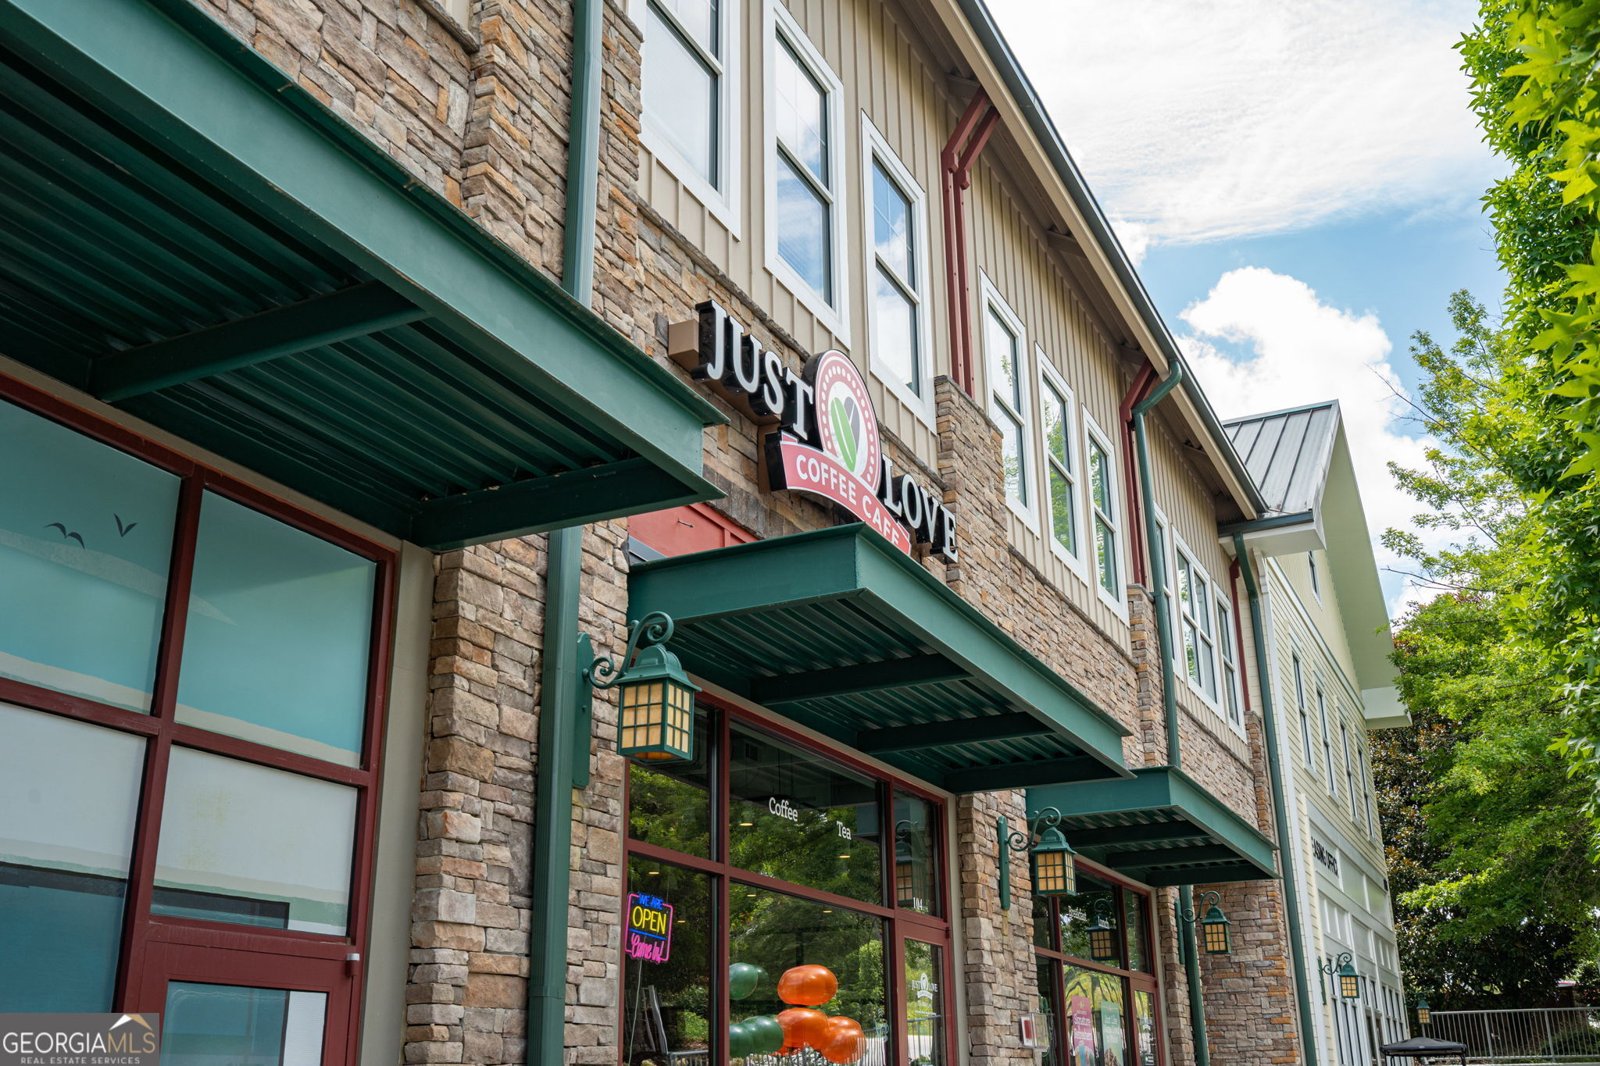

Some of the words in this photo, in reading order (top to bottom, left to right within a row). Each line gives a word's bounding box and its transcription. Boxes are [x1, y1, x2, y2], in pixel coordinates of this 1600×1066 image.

[697, 299, 814, 441] JUST
[796, 454, 857, 506] COFFEE
[882, 453, 959, 564] LOVE
[768, 796, 799, 822] Coffee
[836, 820, 852, 840] Tea
[632, 905, 667, 935] OPEN
